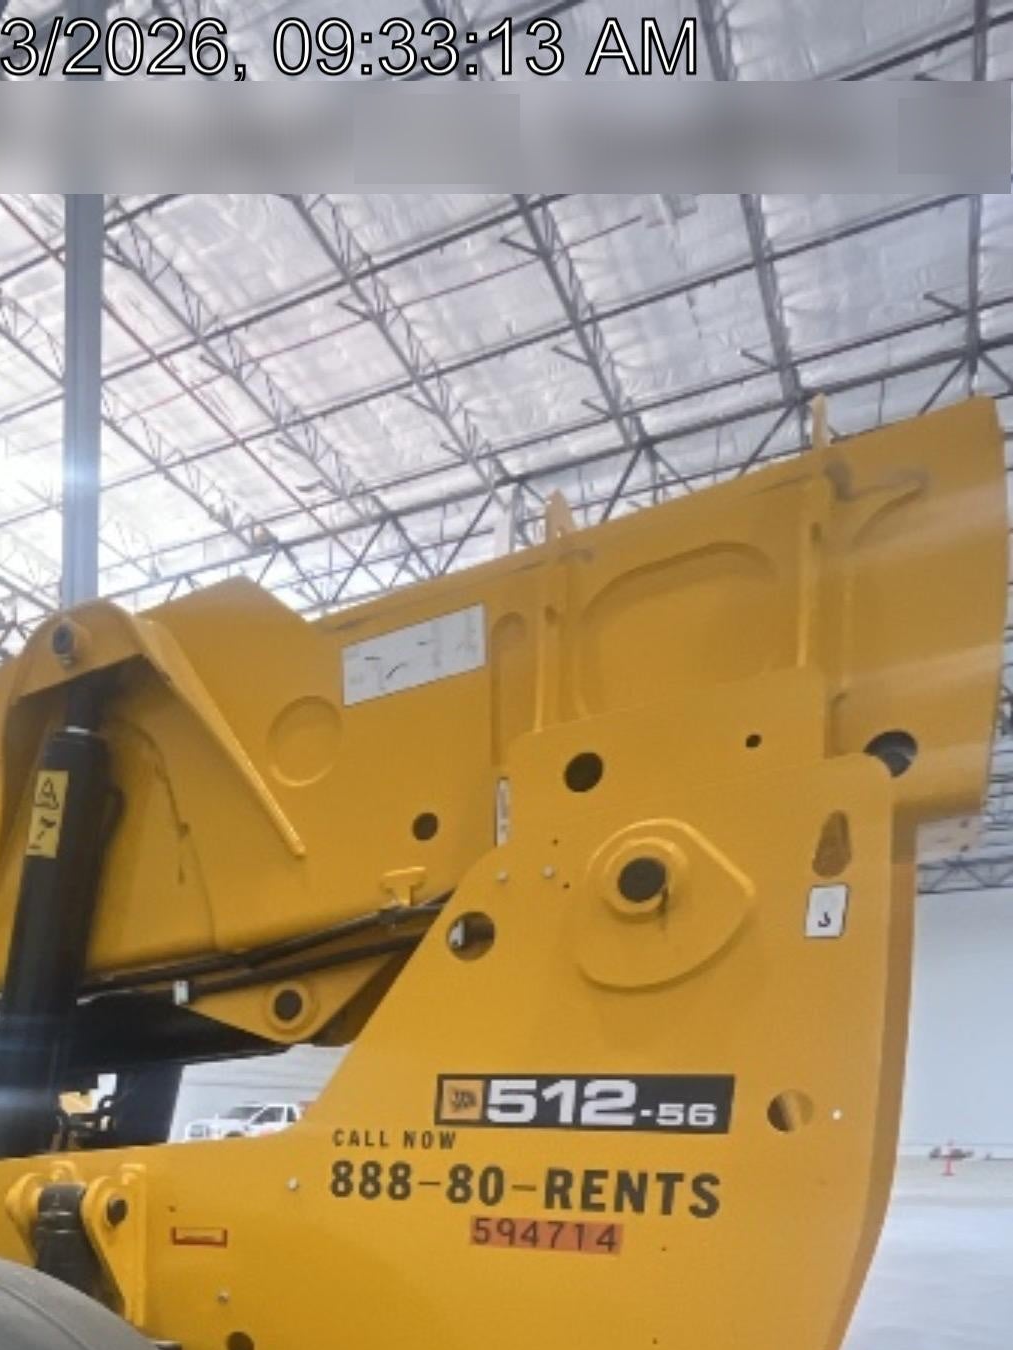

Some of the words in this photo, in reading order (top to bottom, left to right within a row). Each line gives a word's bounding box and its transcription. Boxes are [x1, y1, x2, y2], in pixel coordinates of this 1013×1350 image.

[486, 1079, 717, 1128] 512-56
[332, 1129, 390, 1148] CALL
[403, 1129, 457, 1150] NOW
[329, 1158, 722, 1219] 888-80-RENTS
[472, 1217, 618, 1253] 594714
